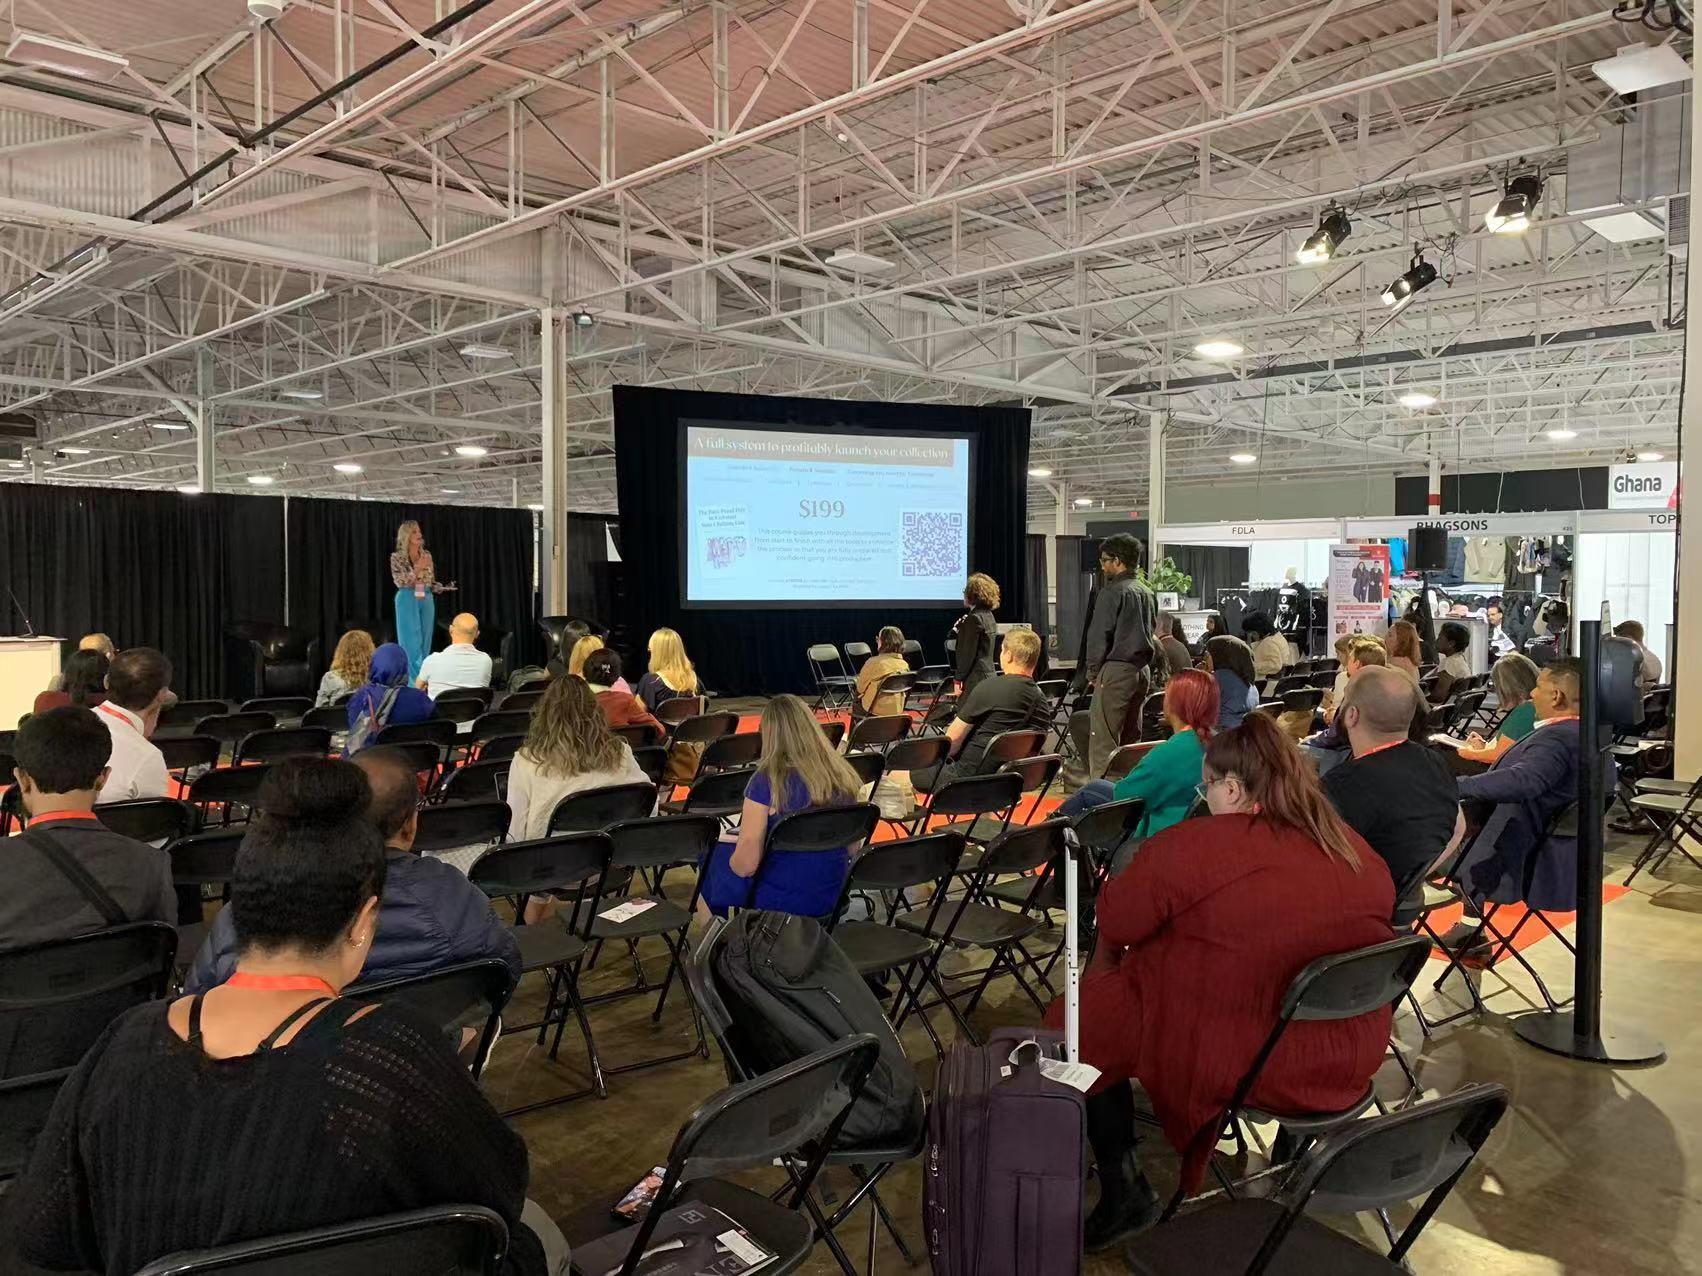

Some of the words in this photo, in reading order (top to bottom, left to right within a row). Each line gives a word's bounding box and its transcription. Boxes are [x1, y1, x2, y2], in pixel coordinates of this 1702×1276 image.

[694, 437, 704, 449] A
[706, 437, 725, 450] full
[727, 440, 766, 454] system
[768, 441, 780, 452] to
[781, 442, 832, 456] profitably
[835, 443, 871, 457] launch
[873, 447, 898, 459] your
[900, 447, 949, 460] collection
[1614, 474, 1662, 493] Ghana
[799, 499, 845, 519] $199
[1648, 514, 1677, 525] TOP
[1232, 526, 1255, 535] FDLA
